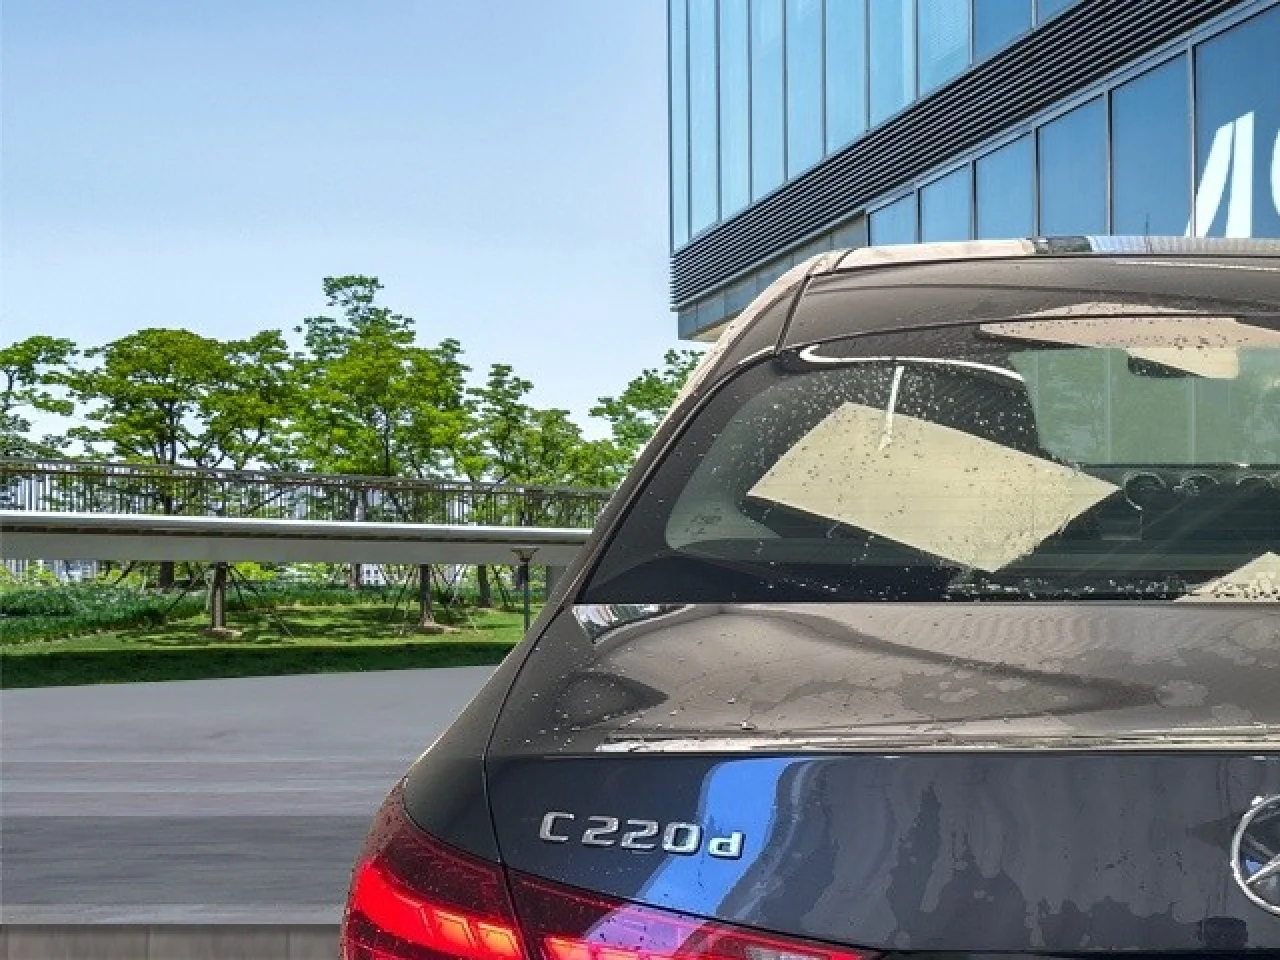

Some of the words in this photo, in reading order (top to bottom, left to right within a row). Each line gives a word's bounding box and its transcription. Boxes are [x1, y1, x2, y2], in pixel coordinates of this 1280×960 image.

[539, 811, 576, 843] C
[581, 815, 702, 855] 220
[707, 831, 744, 859] d
